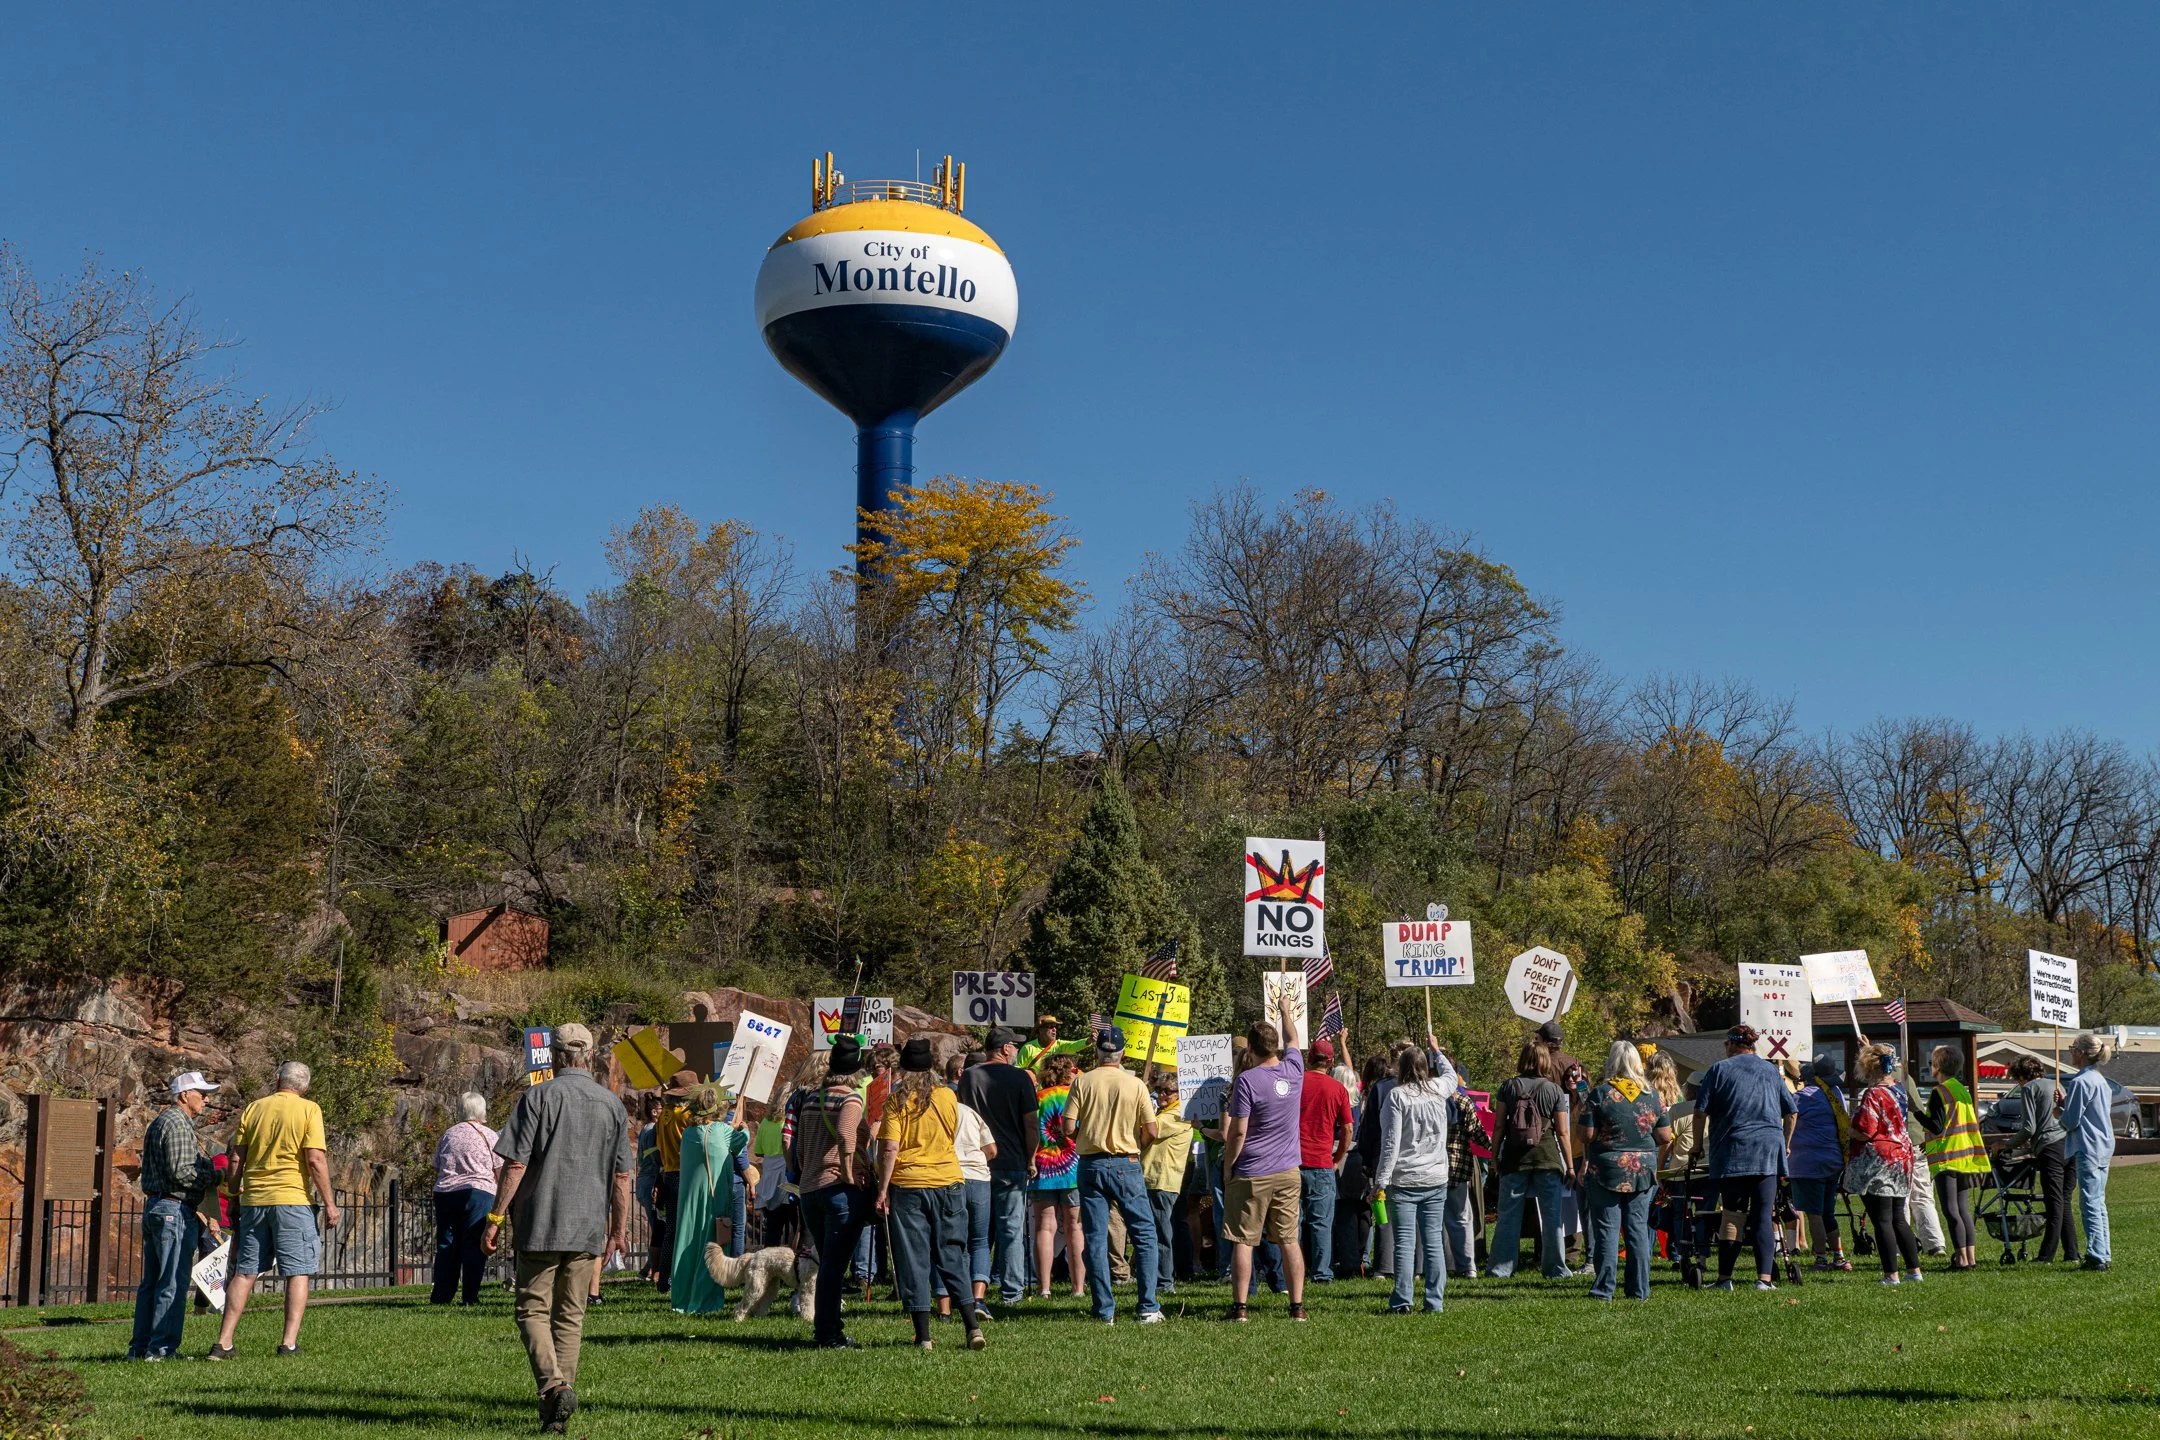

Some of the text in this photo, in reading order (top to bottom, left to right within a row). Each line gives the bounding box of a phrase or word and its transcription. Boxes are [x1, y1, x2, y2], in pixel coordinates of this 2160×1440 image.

[863, 241, 930, 261] City of
[812, 259, 976, 303] Montello
[1257, 904, 1315, 933] NO
[1430, 911, 1445, 919] USA
[1256, 933, 1314, 948] KINGS
[1398, 923, 1452, 943] DUMP
[1402, 943, 1446, 958] KING
[1394, 957, 1465, 977] TRUMP!
[1533, 954, 1561, 971] DON'T
[2040, 955, 2067, 969] Hey Trump
[1523, 968, 1561, 987] FORGET
[1753, 978, 1790, 987] PEOPLE
[2036, 969, 2051, 980] We're
[954, 972, 1033, 998] PRESS
[1130, 980, 1162, 1003] LAST
[1166, 986, 1177, 1004] 3
[1530, 982, 1547, 993] THE
[1523, 990, 1552, 1009] VETS
[1763, 992, 1786, 1000] NOT
[2034, 989, 2073, 1008] We hate you
[862, 1008, 893, 1024] INGS
[969, 997, 1007, 1022] ON
[2040, 1006, 2068, 1023] for FREE
[747, 1019, 782, 1038] 8647
[1761, 1028, 1792, 1036] KING
[529, 1032, 551, 1048] FOR TH
[1176, 1036, 1231, 1052] DEMOCRACY
[531, 1047, 553, 1065] PEOPL
[1184, 1053, 1216, 1063] DOESN'T
[1178, 1067, 1199, 1077] FEAR
[1200, 1103, 1218, 1115] DO
